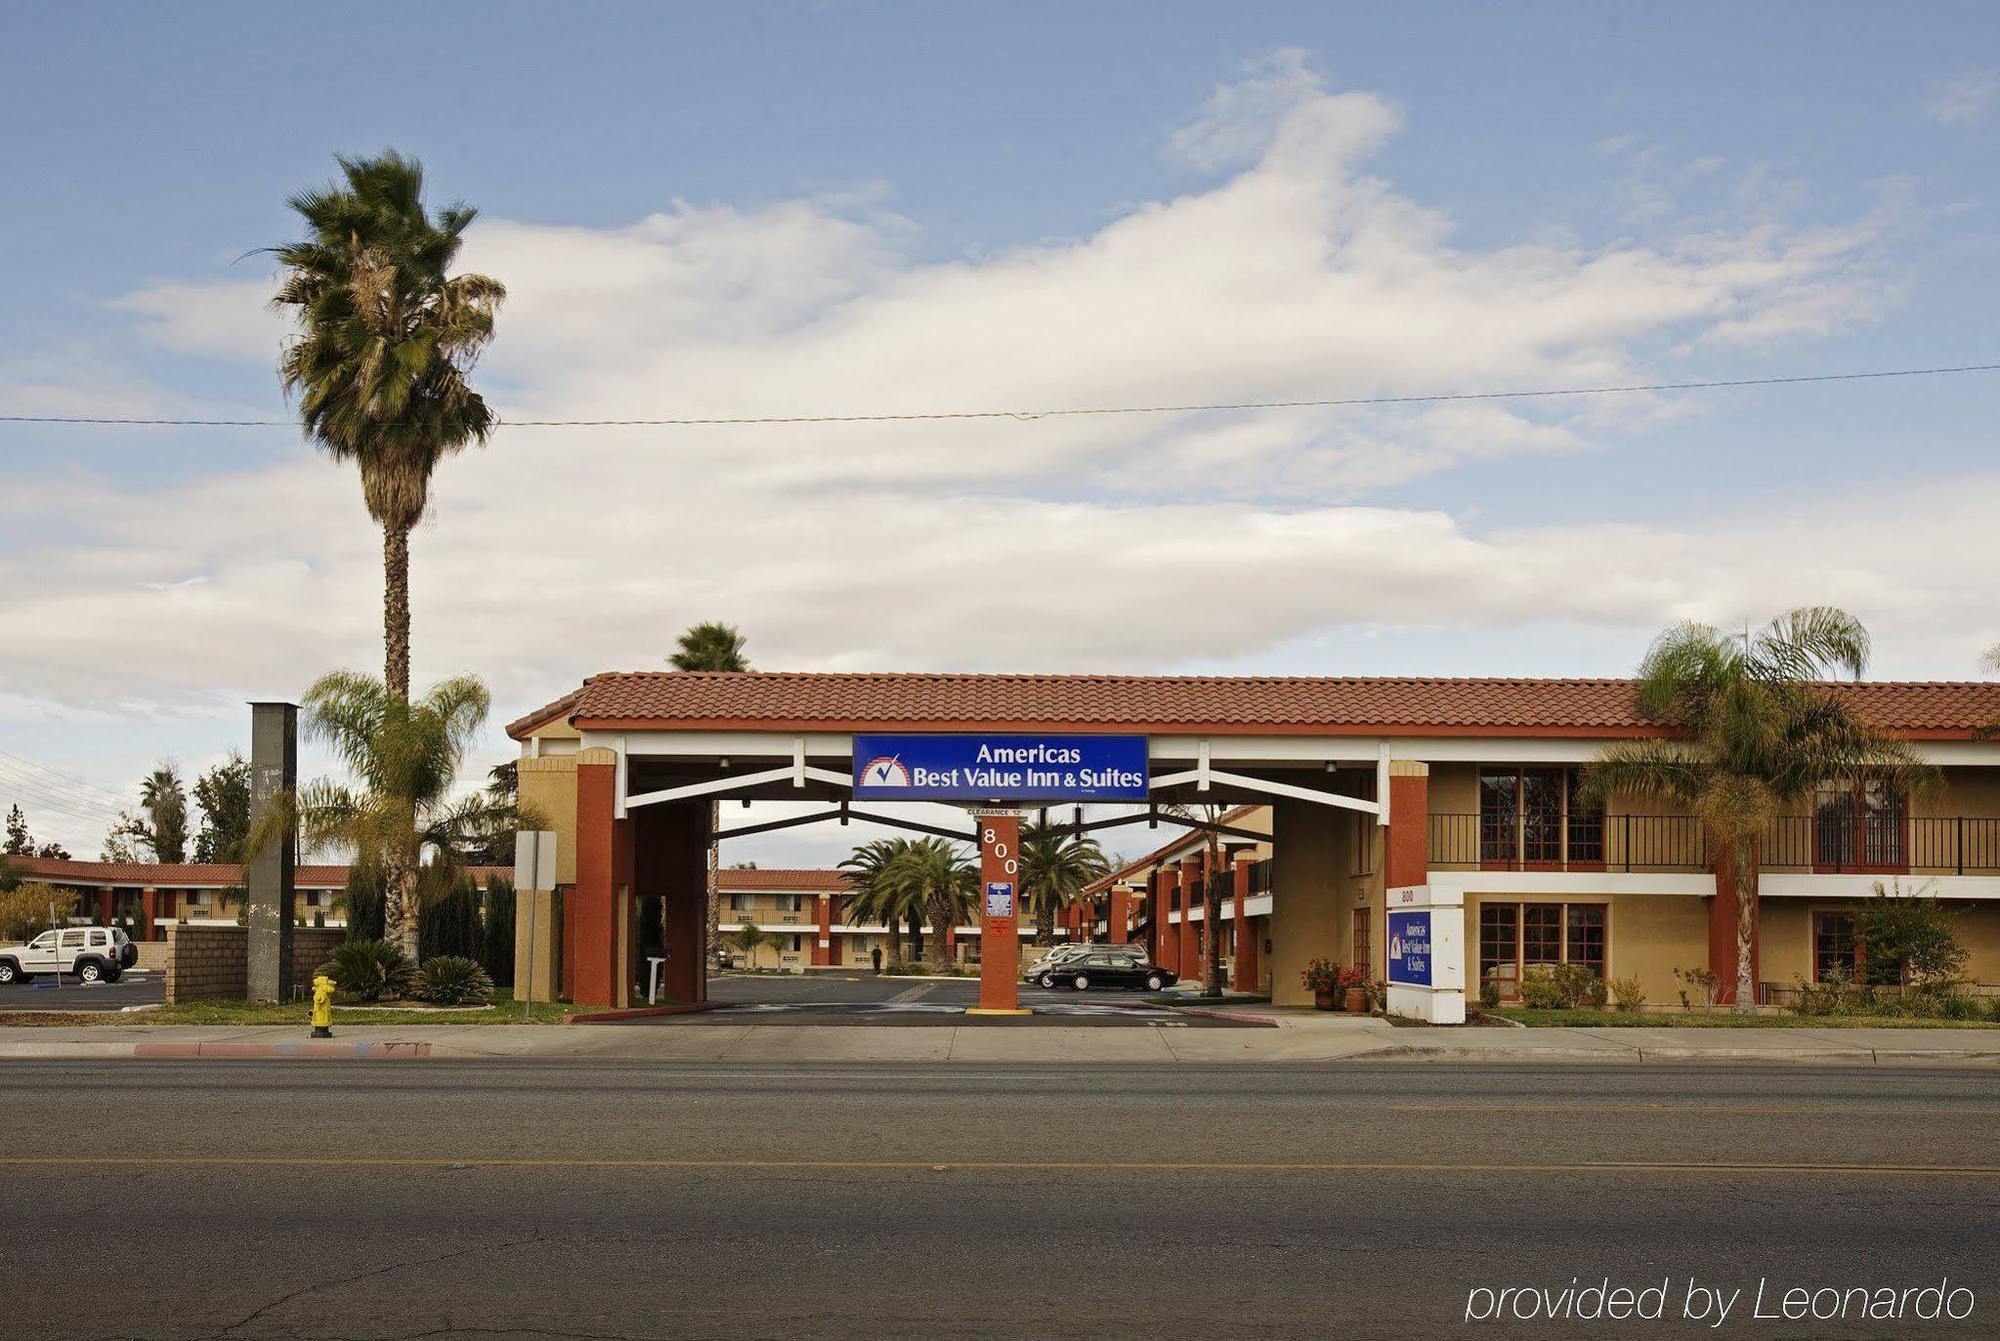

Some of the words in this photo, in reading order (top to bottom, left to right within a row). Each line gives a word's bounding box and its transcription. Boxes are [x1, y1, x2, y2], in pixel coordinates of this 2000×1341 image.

[976, 744, 1081, 763] Americas
[914, 768, 959, 787] Best
[965, 768, 1021, 787] Value
[1027, 769, 1060, 787] Inn
[1063, 772, 1077, 787] &
[1080, 768, 1143, 787] Suites
[984, 829, 1017, 874] 800
[1402, 890, 1413, 903] 800
[1406, 922, 1425, 937] Americas
[1402, 939, 1411, 954] Best
[1412, 938, 1422, 954] Value
[1423, 940, 1431, 954] Inn
[1412, 956, 1425, 972] Suites
